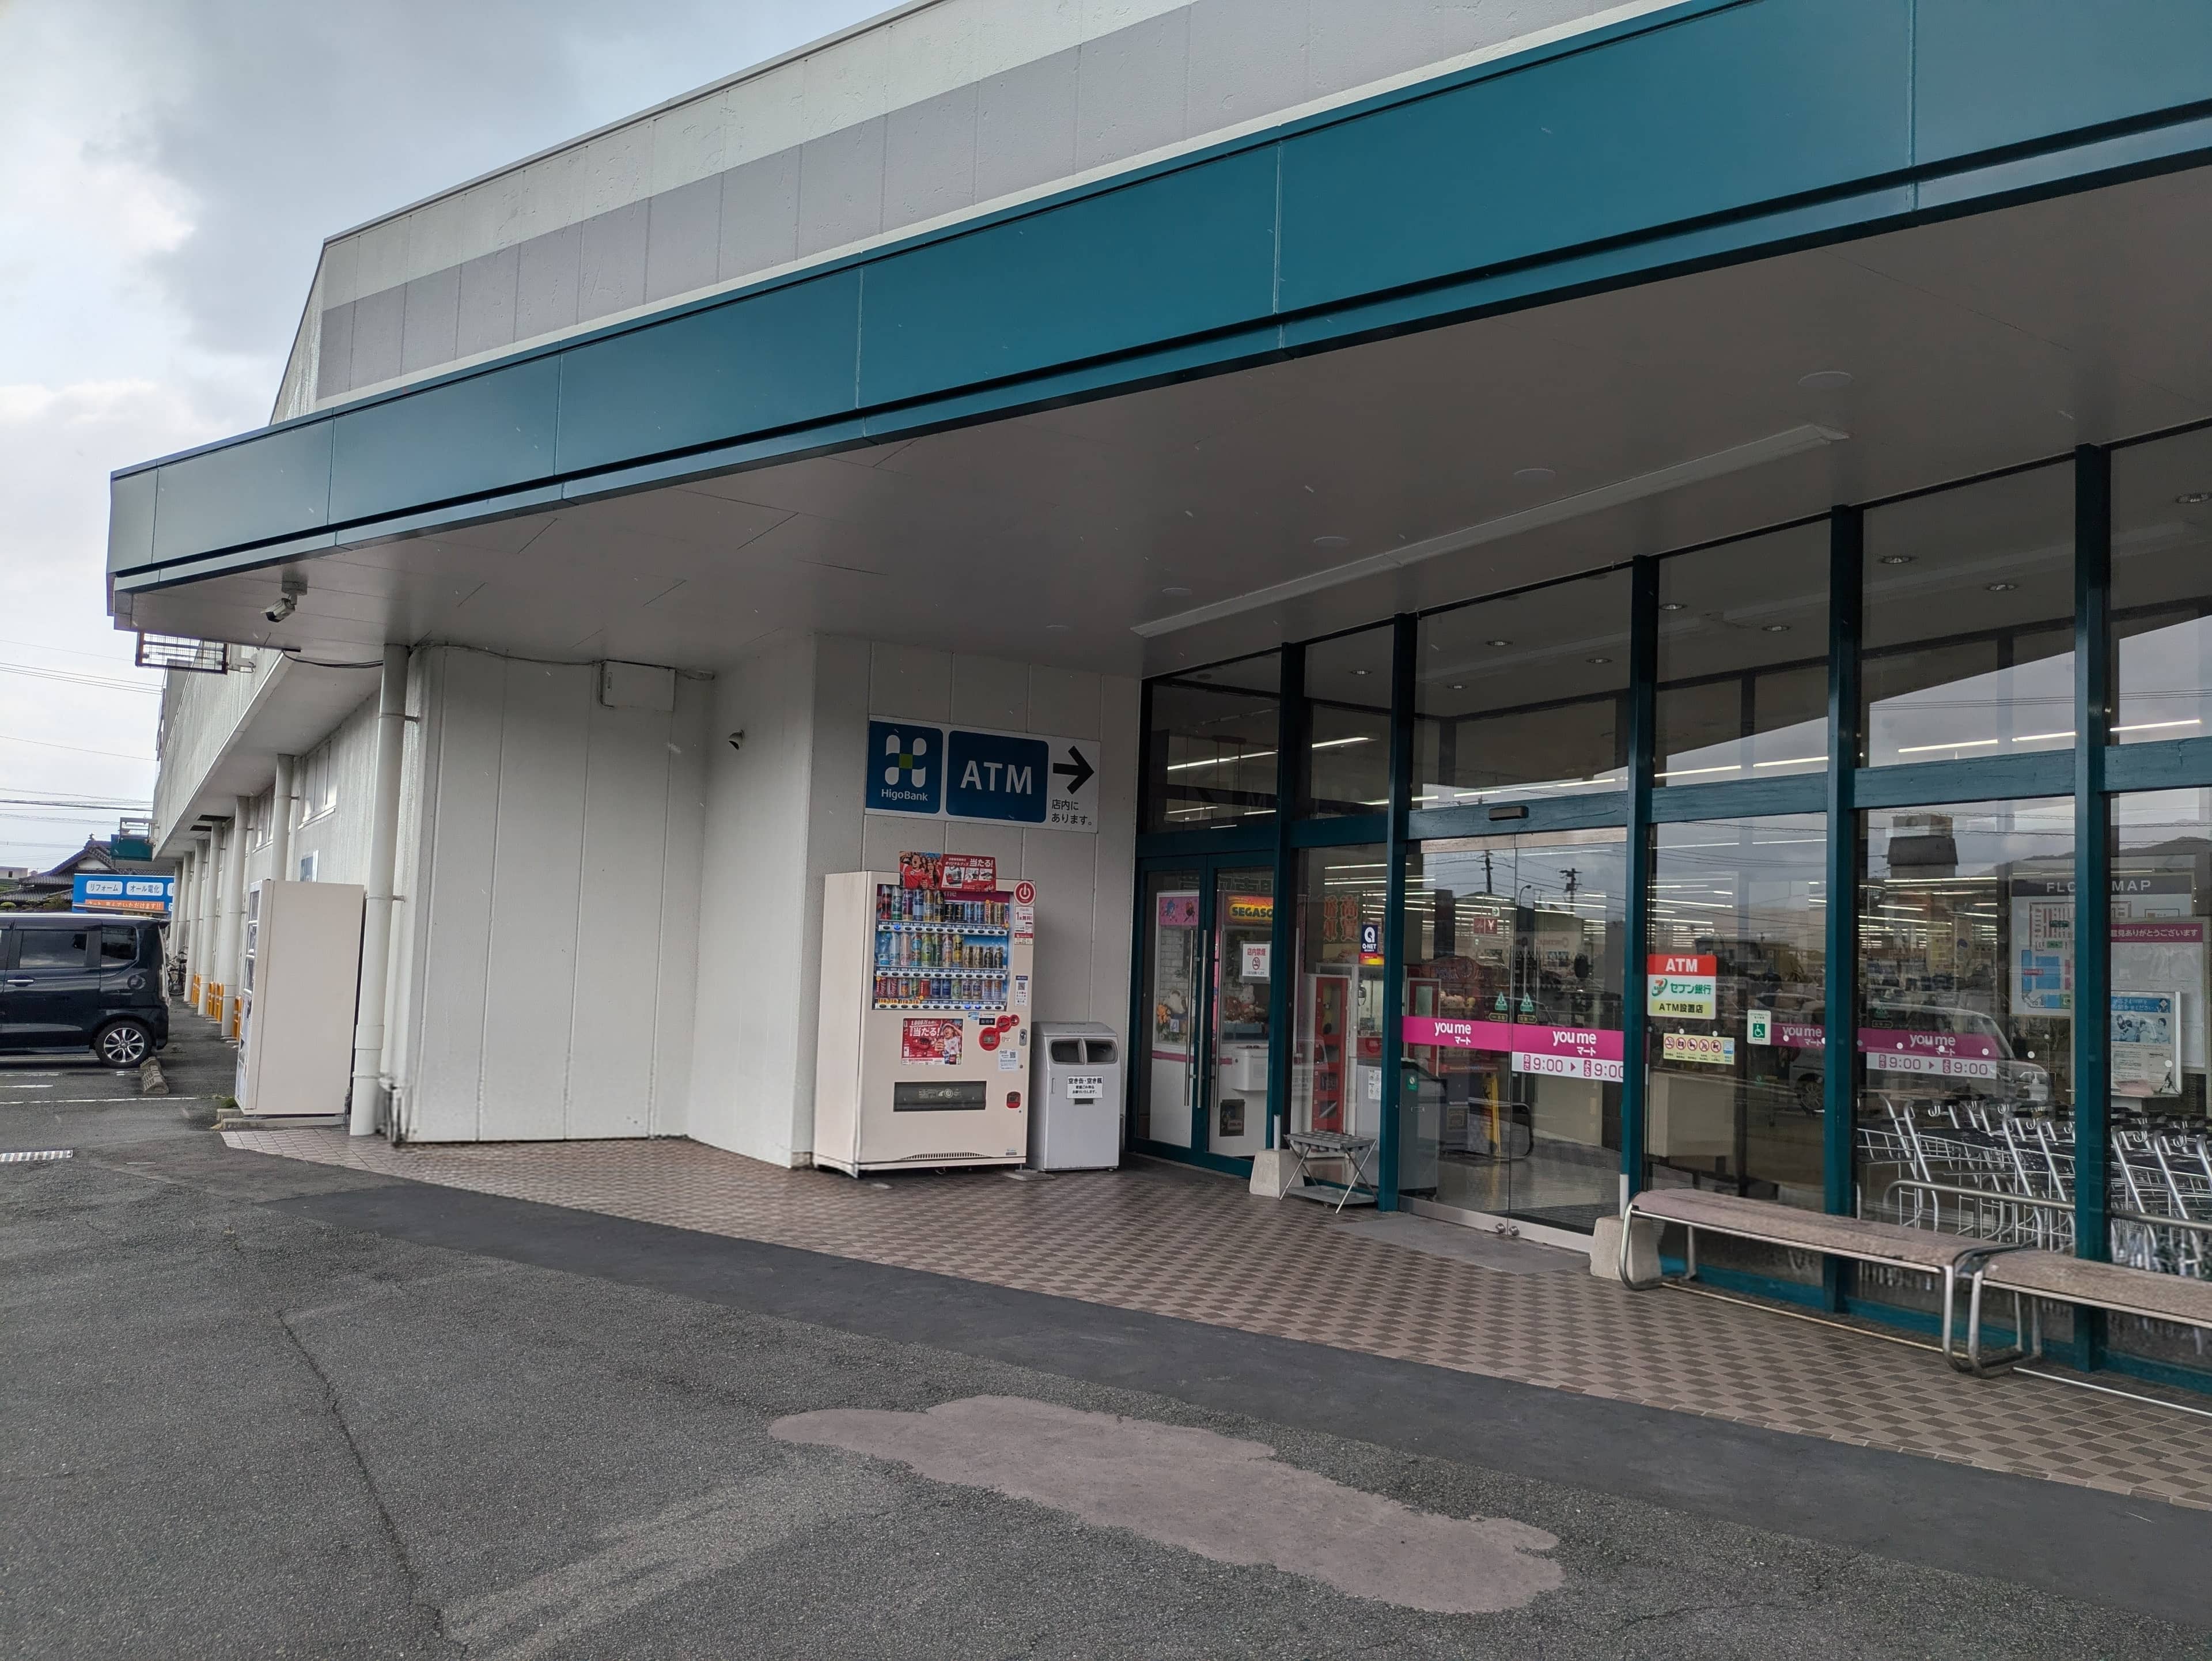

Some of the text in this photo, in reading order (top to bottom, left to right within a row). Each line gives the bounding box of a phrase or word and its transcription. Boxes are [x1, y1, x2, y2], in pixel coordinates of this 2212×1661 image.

[960, 760, 1032, 795] ATM
[881, 788, 928, 802] HigoBank
[1051, 799, 1080, 811] 店内に
[1051, 812, 1093, 826] あります。
[90, 883, 160, 894] リフォーム オール電化
[2112, 880, 2152, 891] MAP
[1665, 958, 1698, 973] ATM
[1671, 983, 1711, 995] セブン銀行
[1659, 1003, 1704, 1013] ATM設置店
[1455, 1036, 1471, 1046] マート
[1804, 1038, 1822, 1047] マート
[1577, 1046, 1596, 1057] マート
[1533, 1057, 1563, 1072] 9:00
[1889, 1057, 1921, 1070] 9:00
[1954, 1062, 1988, 1075] 9:00
